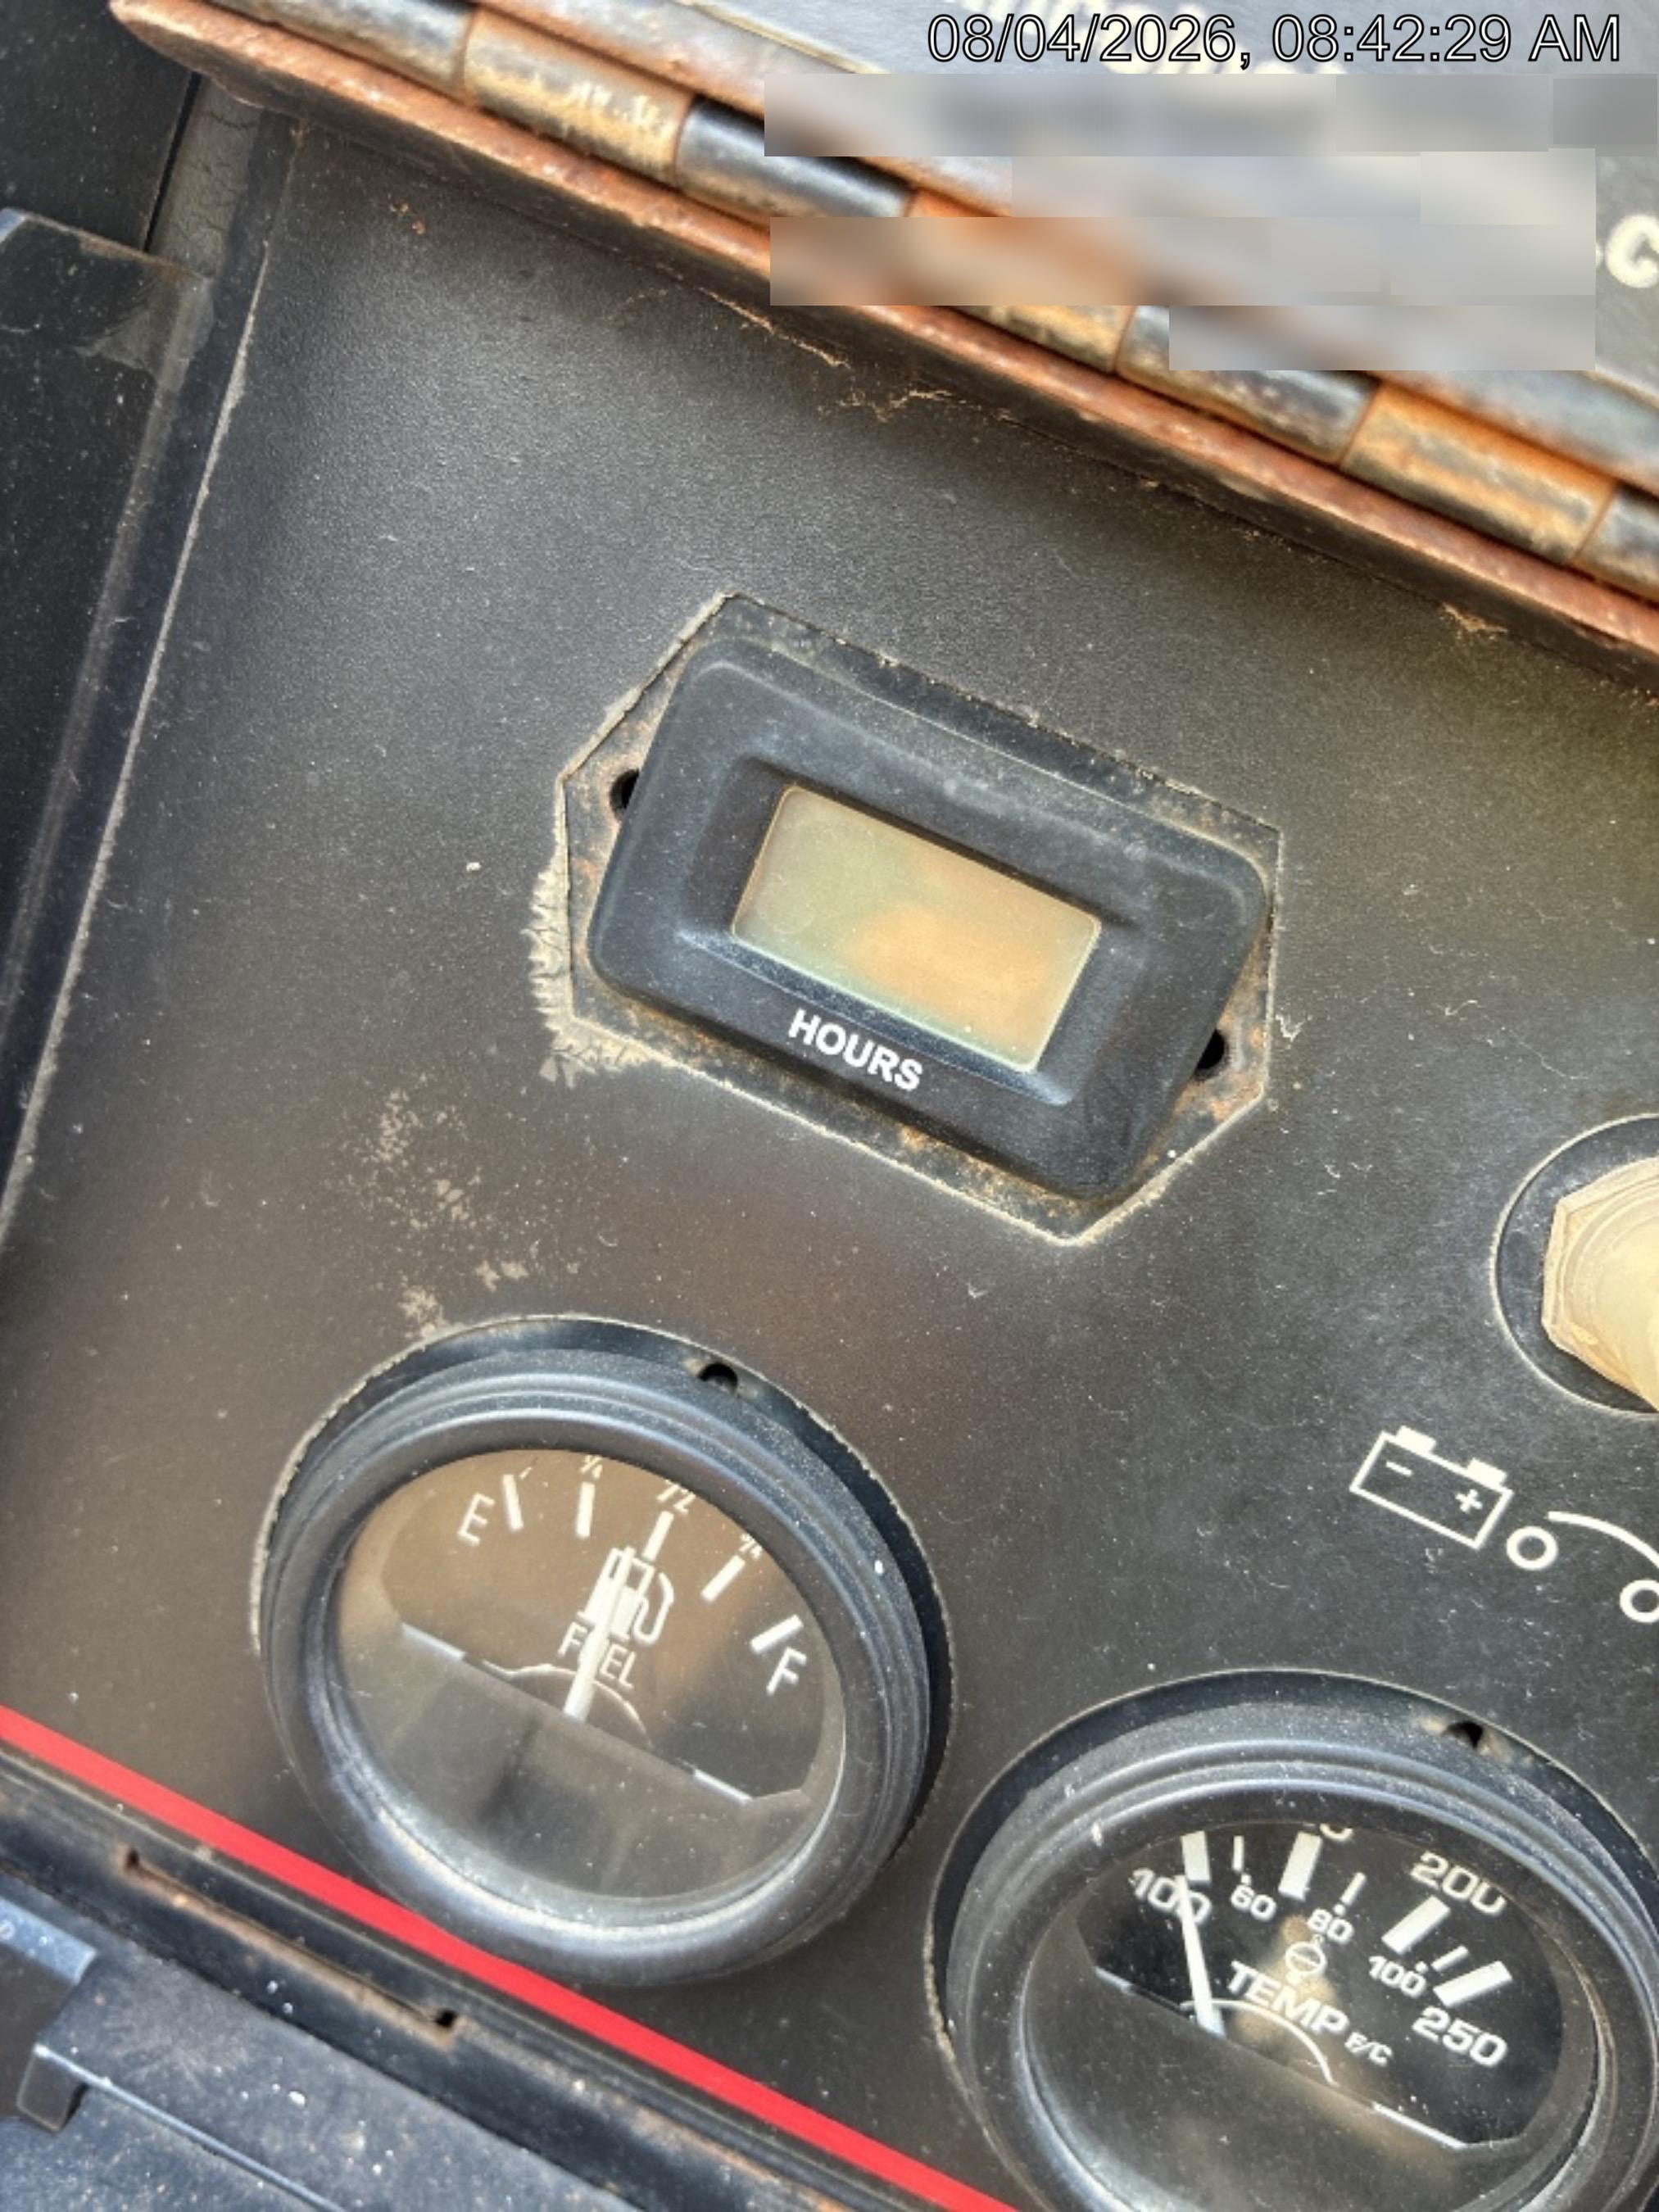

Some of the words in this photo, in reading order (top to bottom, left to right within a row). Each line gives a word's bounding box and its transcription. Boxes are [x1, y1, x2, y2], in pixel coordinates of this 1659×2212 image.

[787, 1008, 923, 1093] HOURS
[456, 1492, 496, 1547] E
[558, 1620, 634, 1690] FEL
[766, 1647, 808, 1696] F
[1129, 1867, 1213, 1924] 100
[1230, 1884, 1277, 1921] 60
[1409, 1851, 1507, 1916] 200
[1306, 1907, 1354, 1945] 80
[1227, 1960, 1349, 2038] TEMP
[1367, 1954, 1427, 1997] 100
[1411, 2006, 1509, 2068] 250
